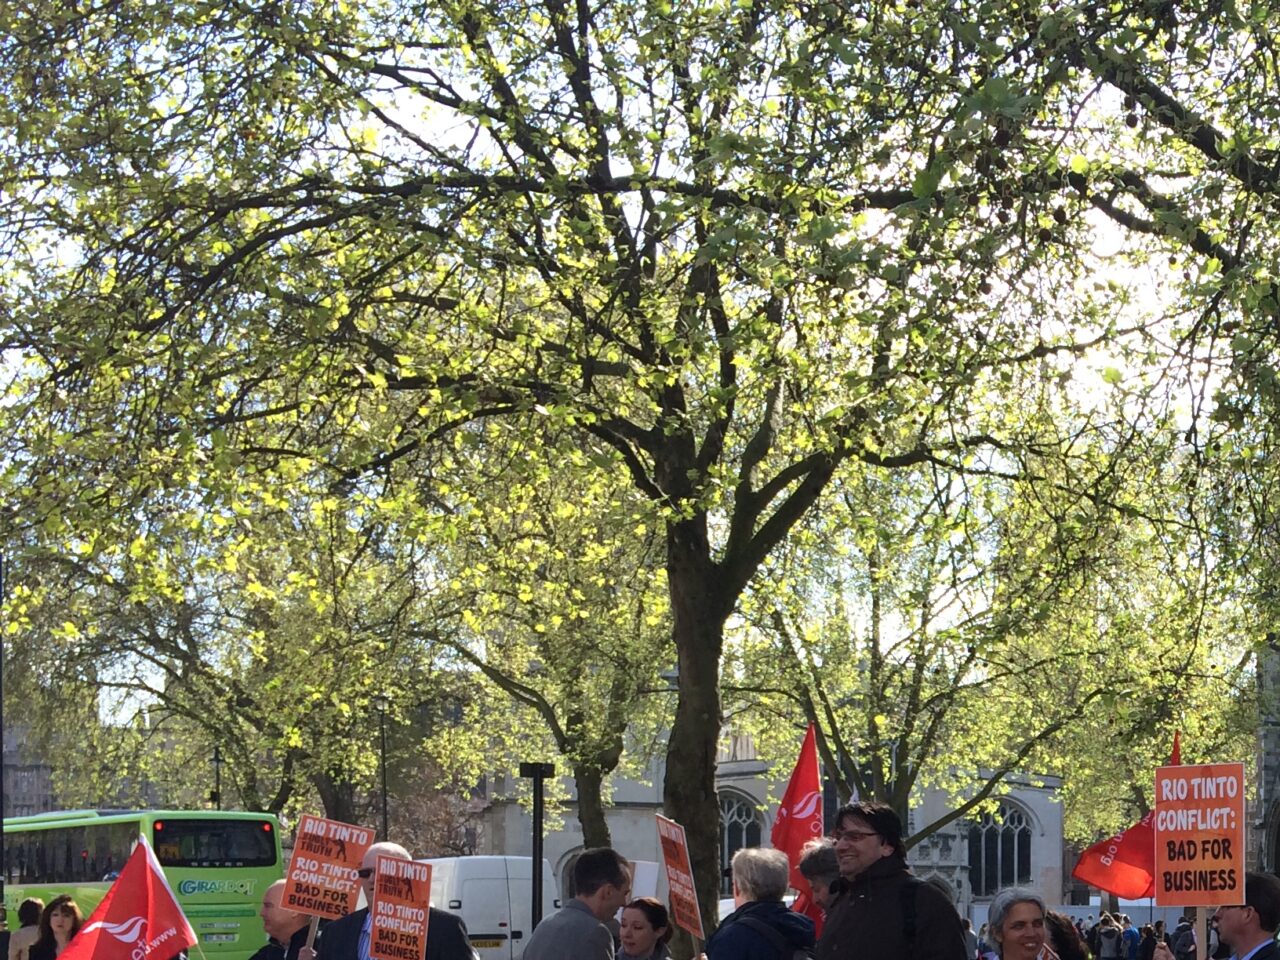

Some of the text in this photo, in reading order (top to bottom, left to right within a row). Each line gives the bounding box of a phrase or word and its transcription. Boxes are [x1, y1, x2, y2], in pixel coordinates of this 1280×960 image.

[1161, 776, 1238, 801] RIO TINTO
[1158, 807, 1236, 832] CONFLICT:
[304, 818, 368, 845] RIO TINTO
[301, 840, 333, 857] TRUTH
[1167, 838, 1233, 861] BAD FOR
[296, 857, 359, 880] RIO TINTO
[380, 859, 396, 875] RIO
[398, 862, 427, 882] TINTO
[178, 879, 256, 895] GIRARDOT
[292, 869, 357, 894] CONFLICT:
[1163, 869, 1237, 892] BUSINESS
[294, 883, 348, 904] BAD FOR
[288, 894, 349, 916] BUSINESS
[377, 901, 425, 922] RIO TINTO
[375, 915, 424, 936] CONFLICT:
[379, 929, 418, 948] BAD FOR
[375, 942, 420, 960] BUSINESS
